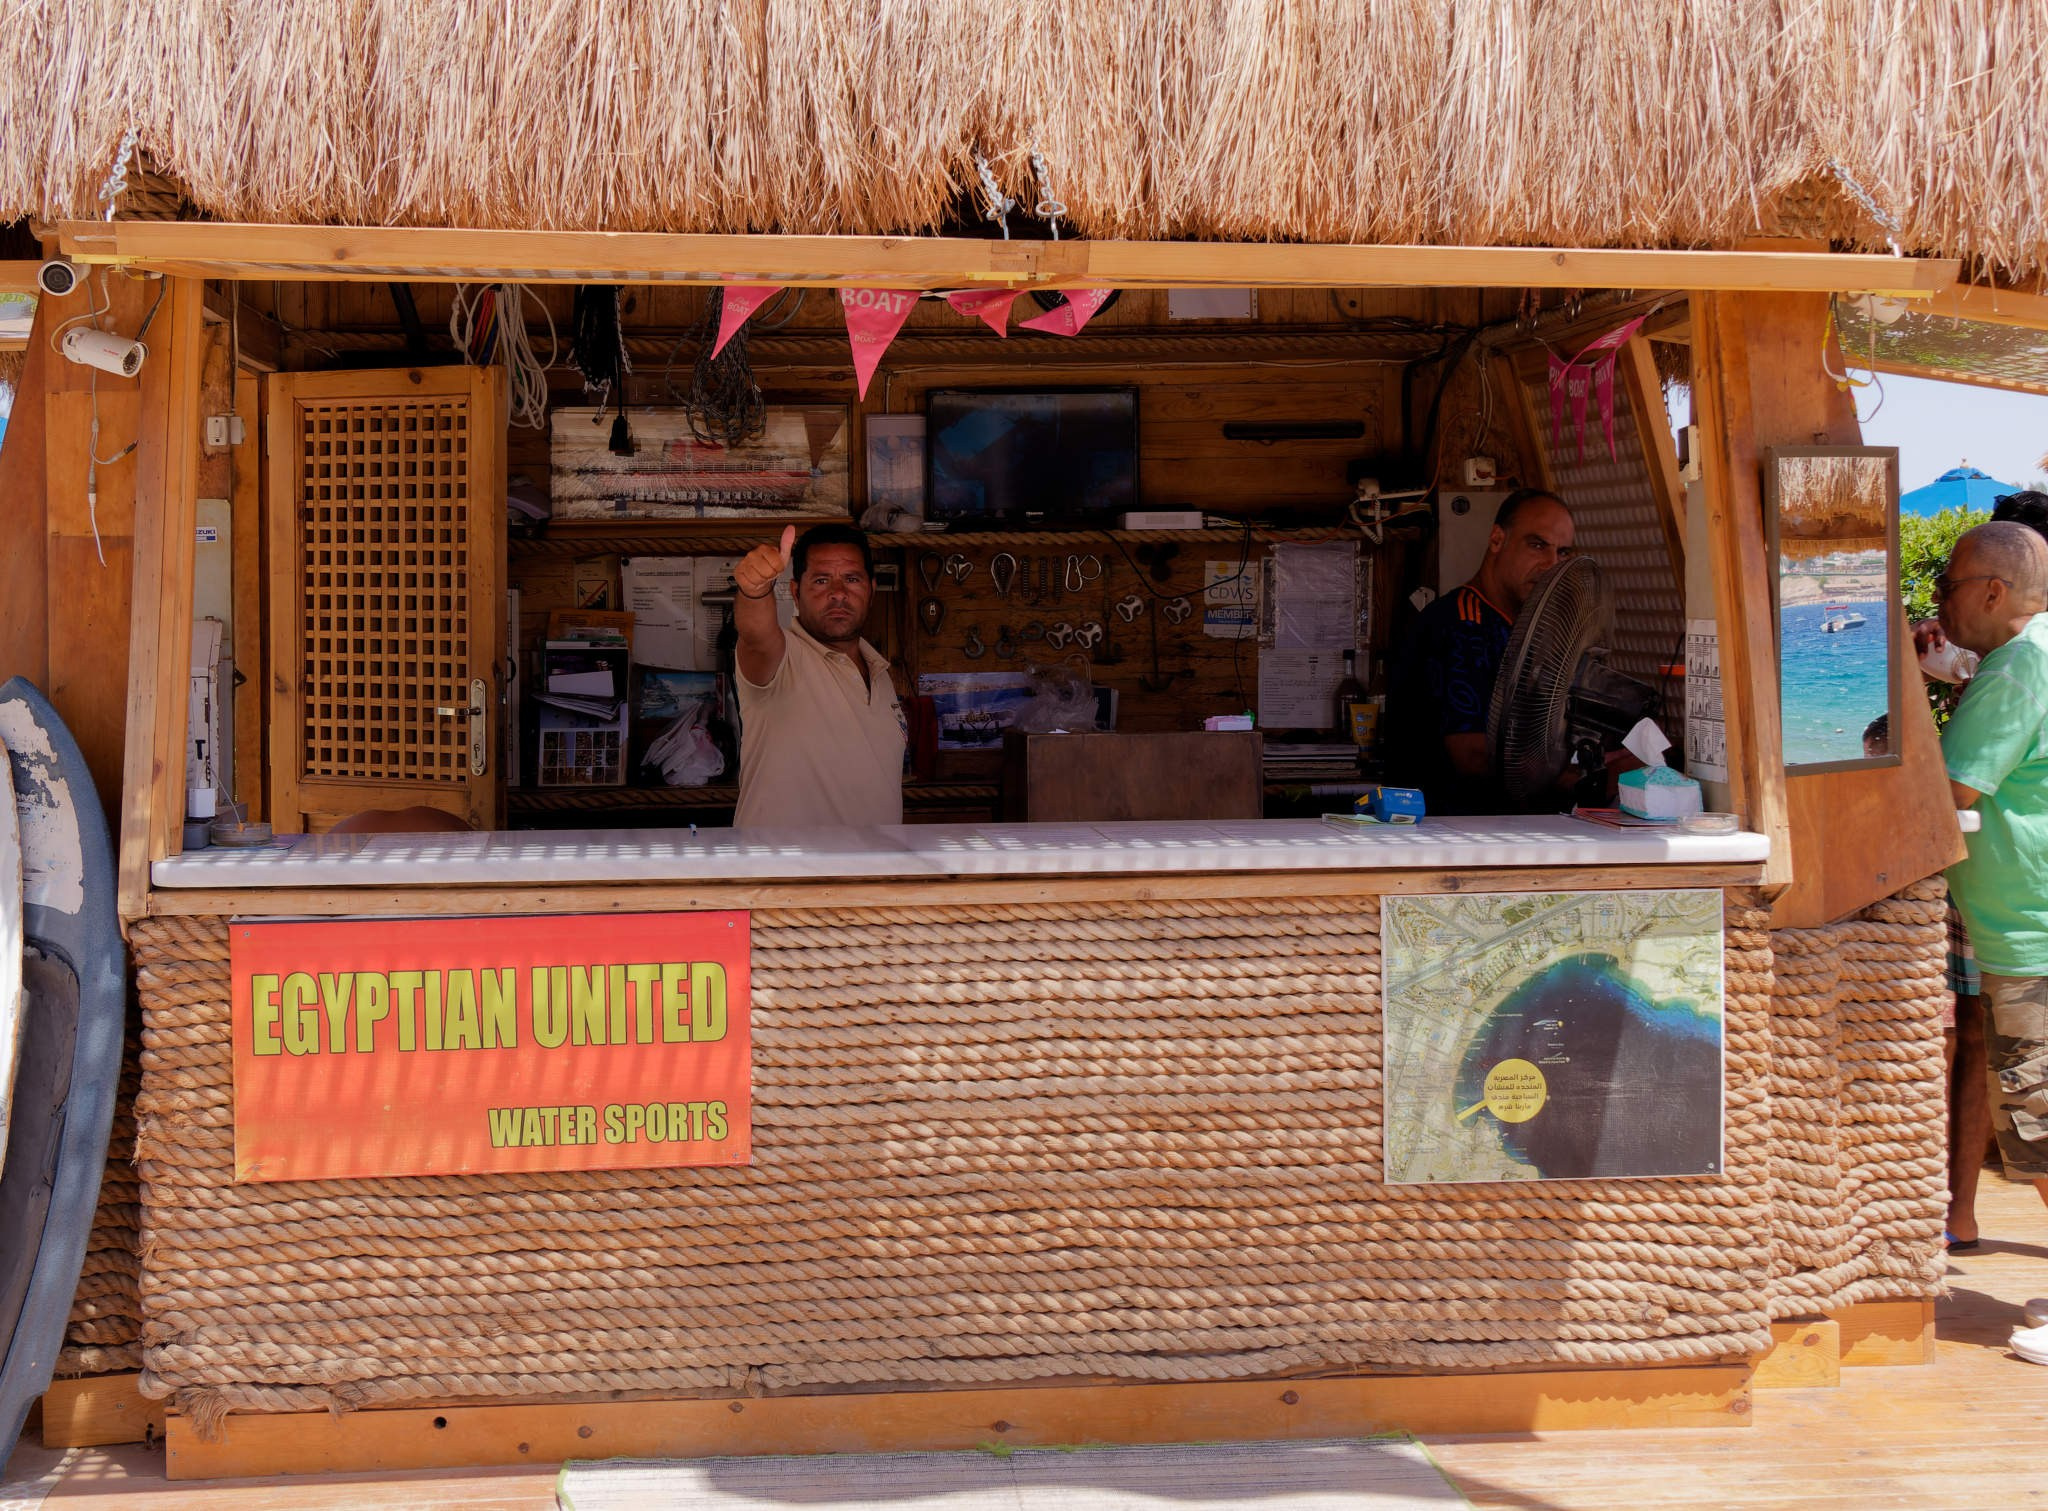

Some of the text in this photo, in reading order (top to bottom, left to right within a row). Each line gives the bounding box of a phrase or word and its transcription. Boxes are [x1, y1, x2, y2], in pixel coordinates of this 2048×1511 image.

[728, 303, 751, 318] BOAT
[841, 288, 907, 315] BOAT
[1208, 587, 1254, 600] CDWS
[251, 961, 729, 1056] EGYPTIAN UNITED
[487, 1100, 729, 1149] WATER SPORTS
